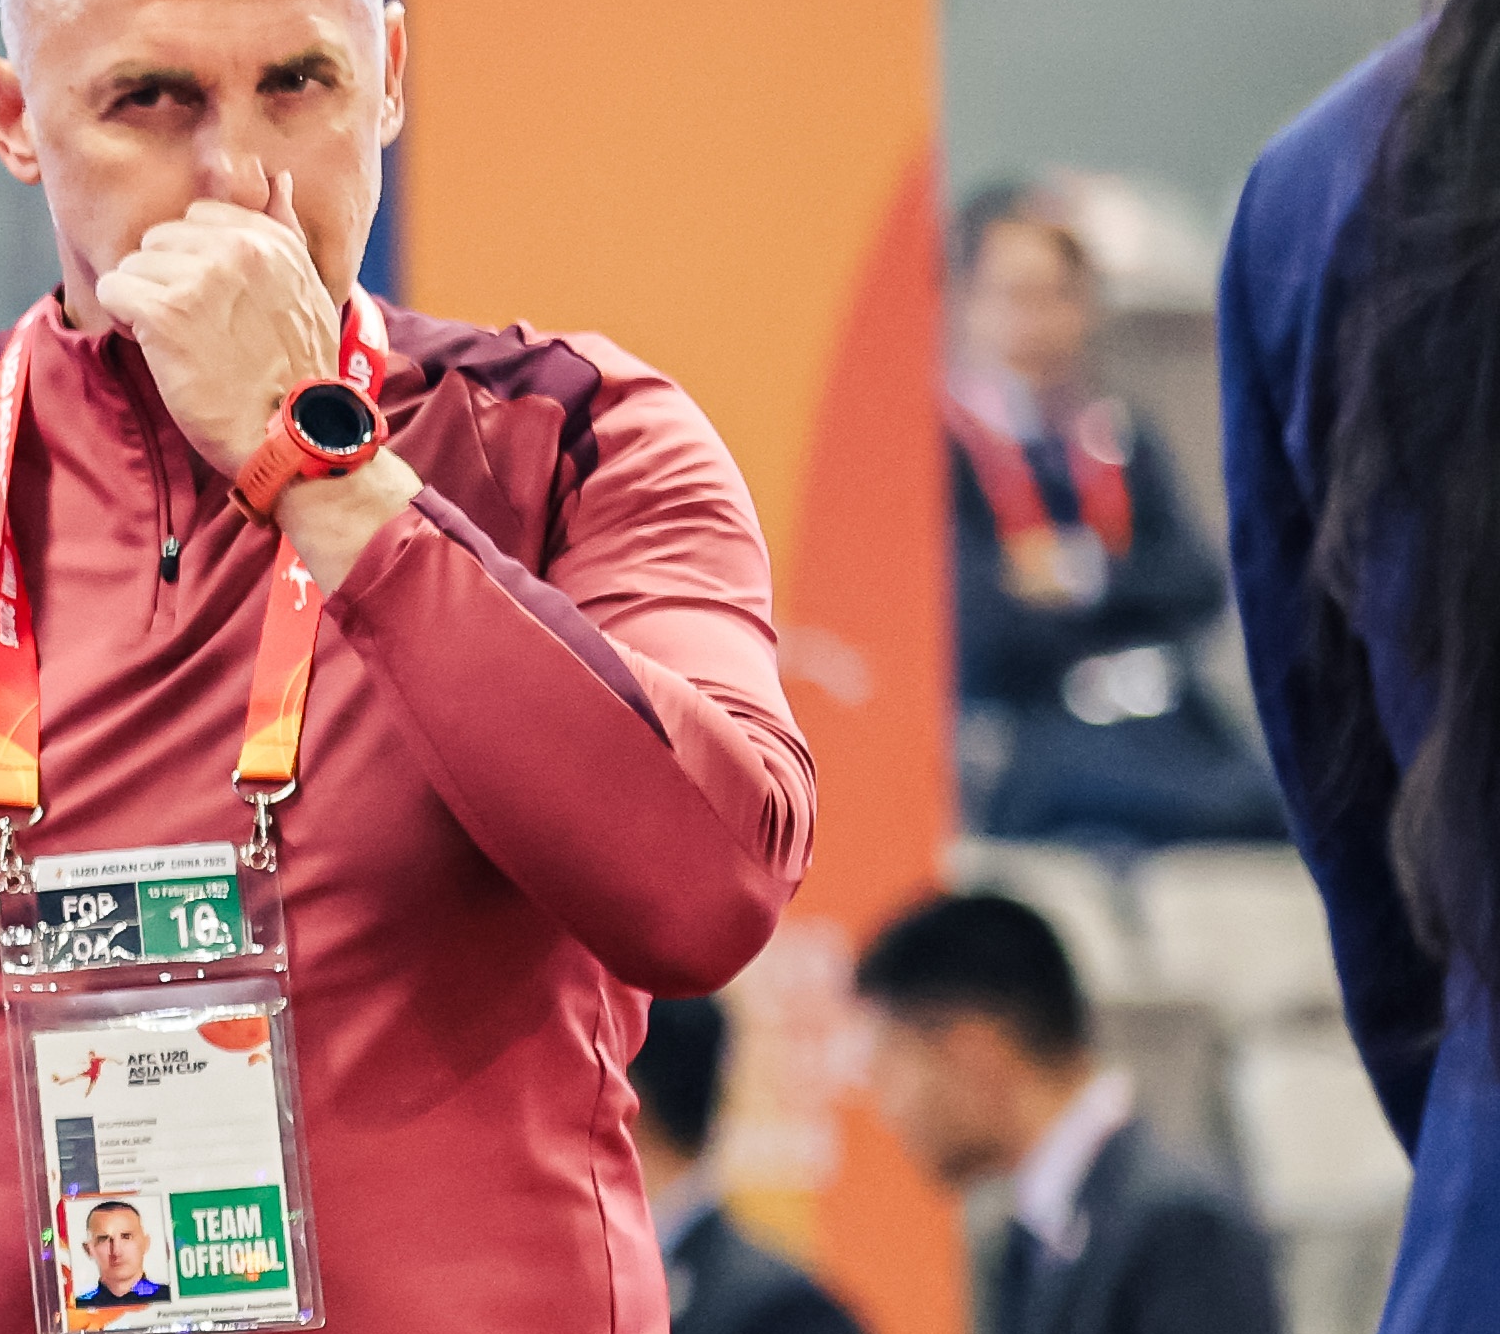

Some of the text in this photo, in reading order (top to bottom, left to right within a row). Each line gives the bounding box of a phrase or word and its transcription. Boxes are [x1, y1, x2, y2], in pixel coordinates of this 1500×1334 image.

[127, 1049, 189, 1067] AFC U20
[128, 1061, 208, 1079] ASIAN CUP
[191, 1204, 263, 1242] TEAM
